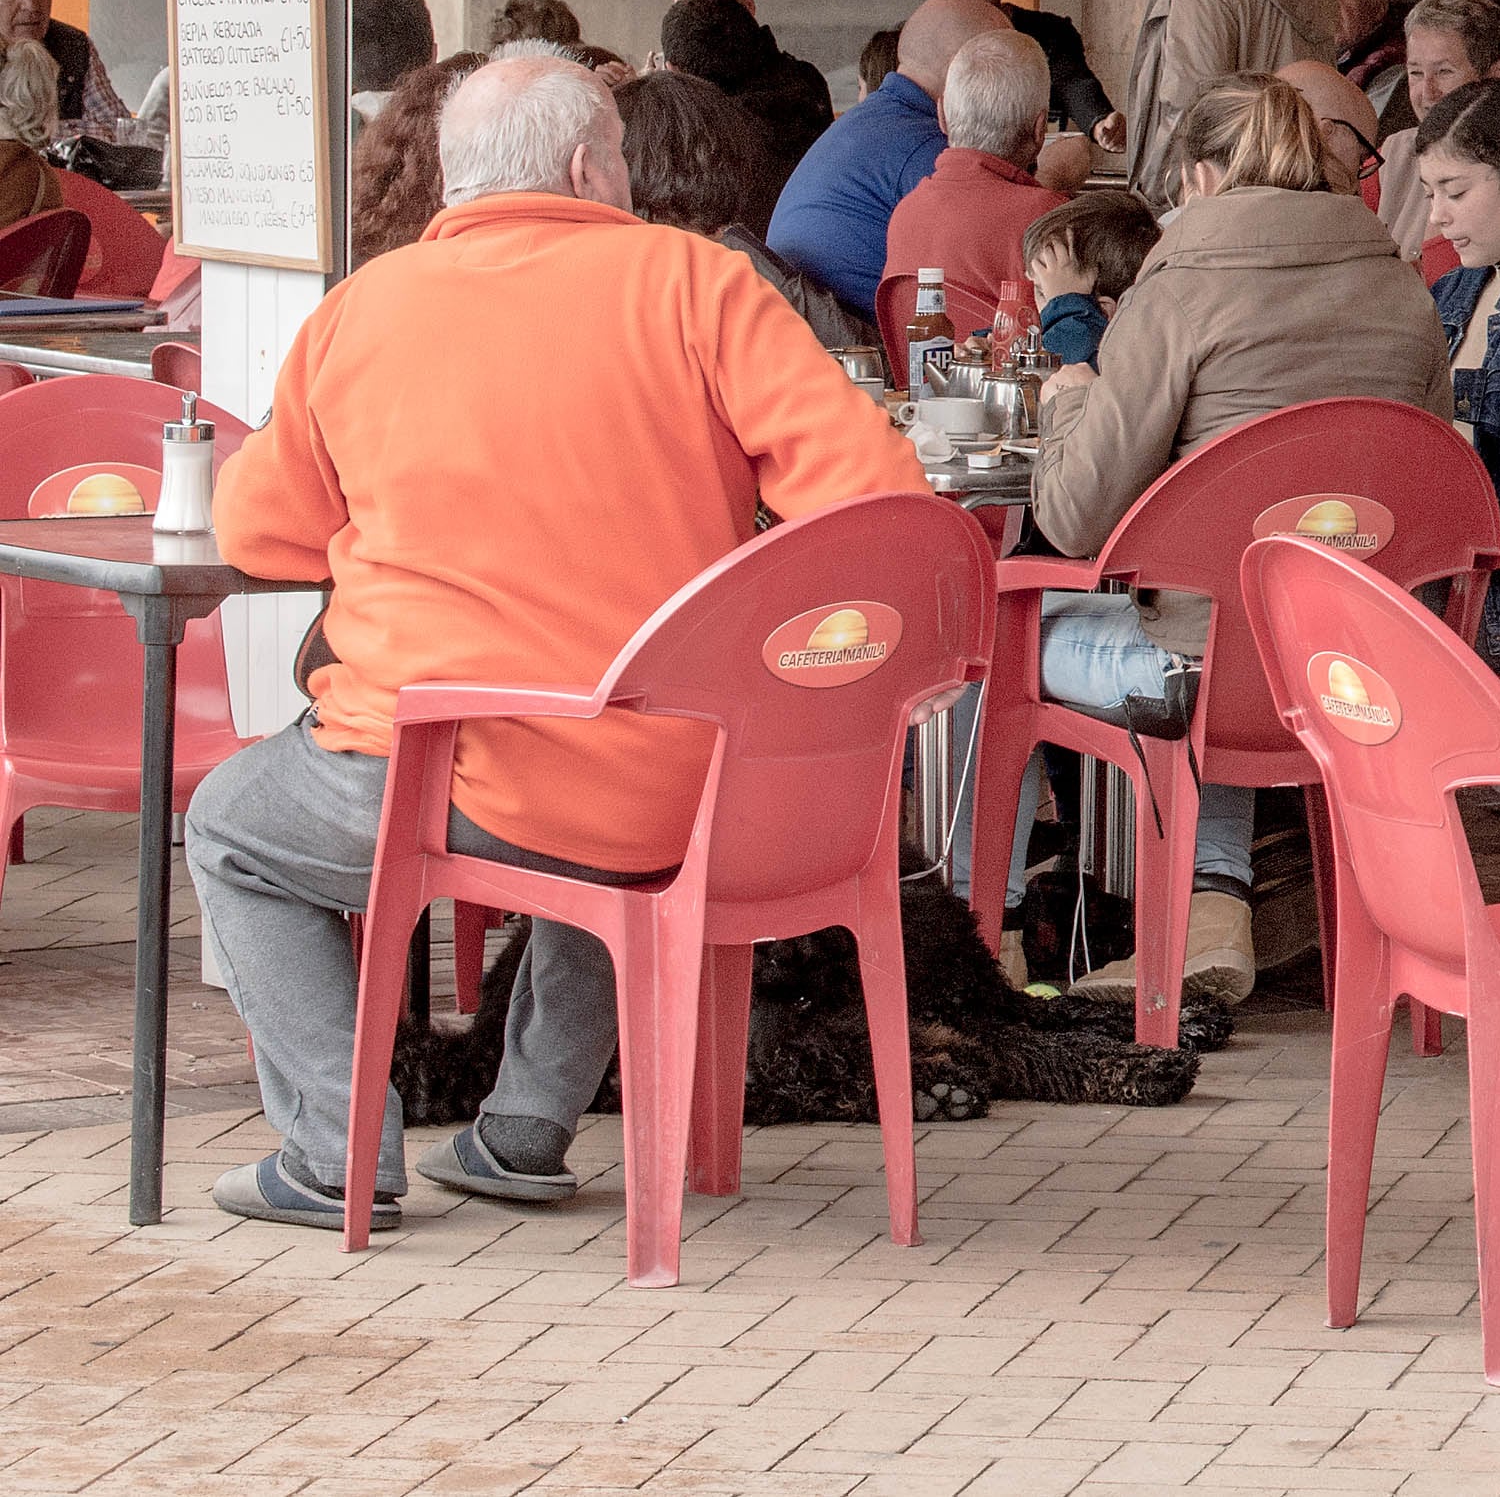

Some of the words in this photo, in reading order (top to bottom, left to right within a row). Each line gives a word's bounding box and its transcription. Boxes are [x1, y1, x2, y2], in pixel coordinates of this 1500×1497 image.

[927, 351, 953, 369] HP
[1335, 535, 1377, 548] MANILA
[780, 649, 843, 667] CAFETERIA
[845, 644, 885, 662] MANILA
